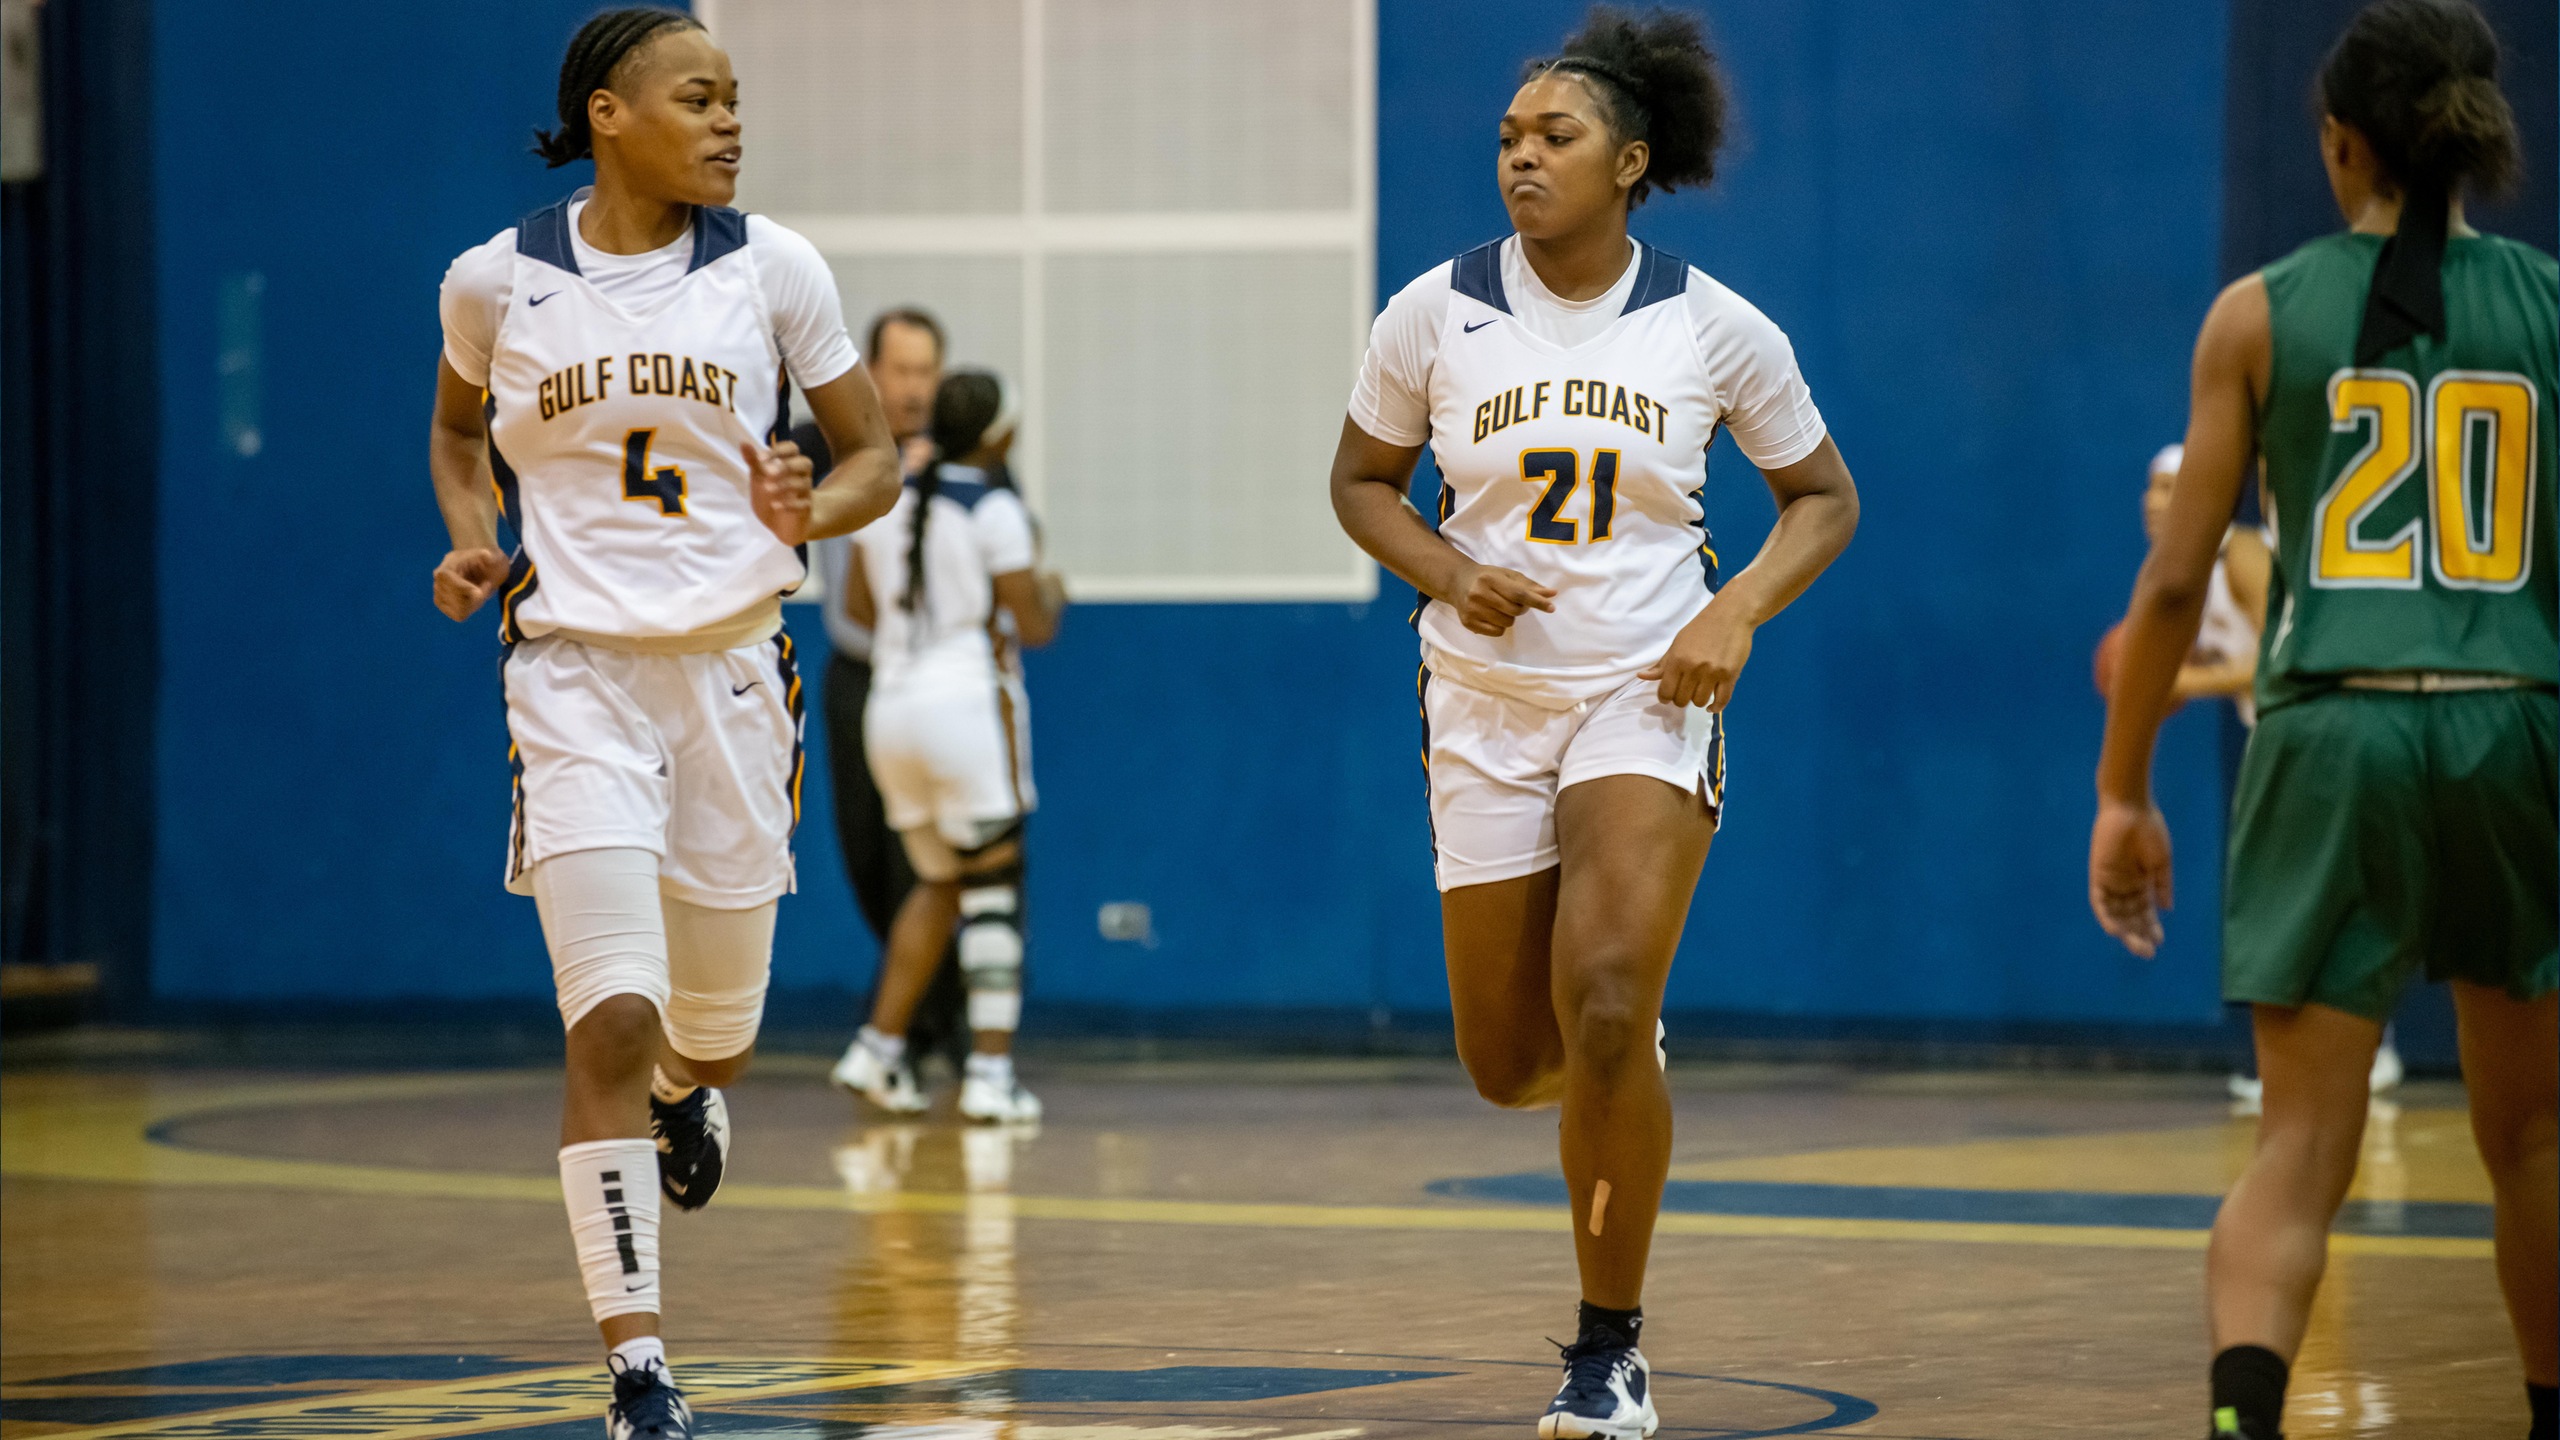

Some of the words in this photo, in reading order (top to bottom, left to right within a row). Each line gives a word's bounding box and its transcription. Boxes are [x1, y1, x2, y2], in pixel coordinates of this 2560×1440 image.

[538, 356, 612, 422] GULF
[627, 352, 738, 414] COAST
[1472, 380, 1551, 445] GULF
[1563, 378, 1669, 445] COAST
[621, 427, 688, 517] 4
[1518, 446, 1622, 545] 21
[2310, 368, 2539, 593] 20
